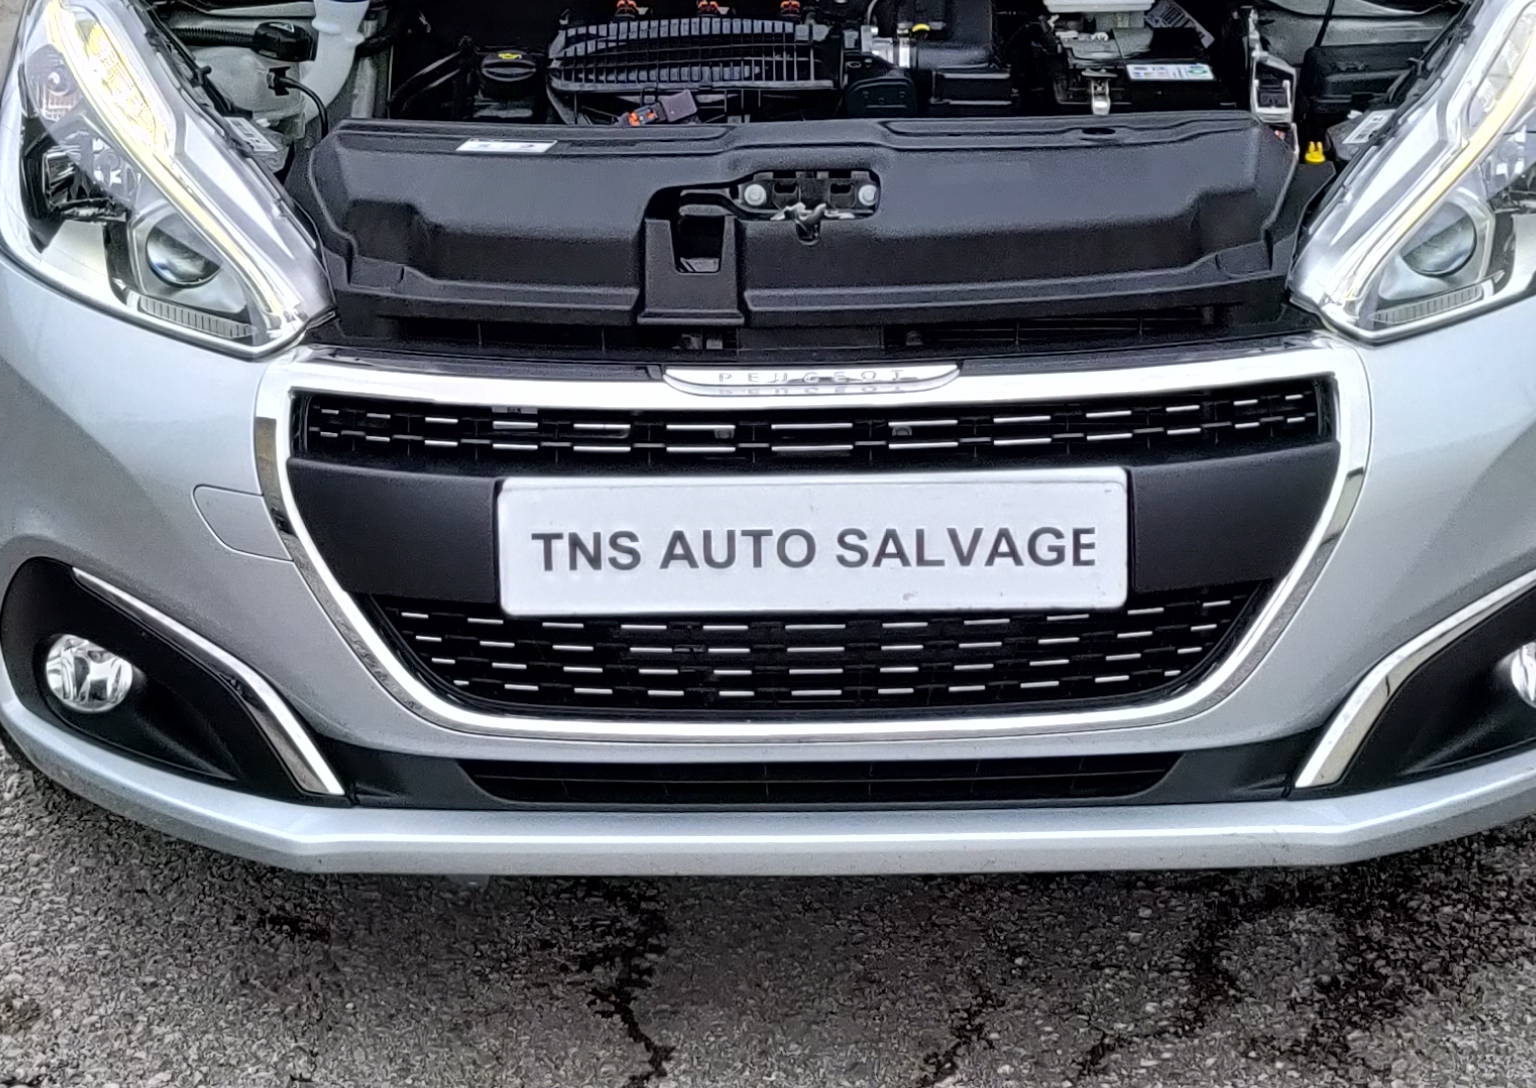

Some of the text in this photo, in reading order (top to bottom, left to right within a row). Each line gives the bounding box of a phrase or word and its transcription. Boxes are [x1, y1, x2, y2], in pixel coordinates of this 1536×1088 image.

[718, 369, 905, 384] PEUGEOT
[530, 525, 1097, 572] TNS AUTO SALVAGE
